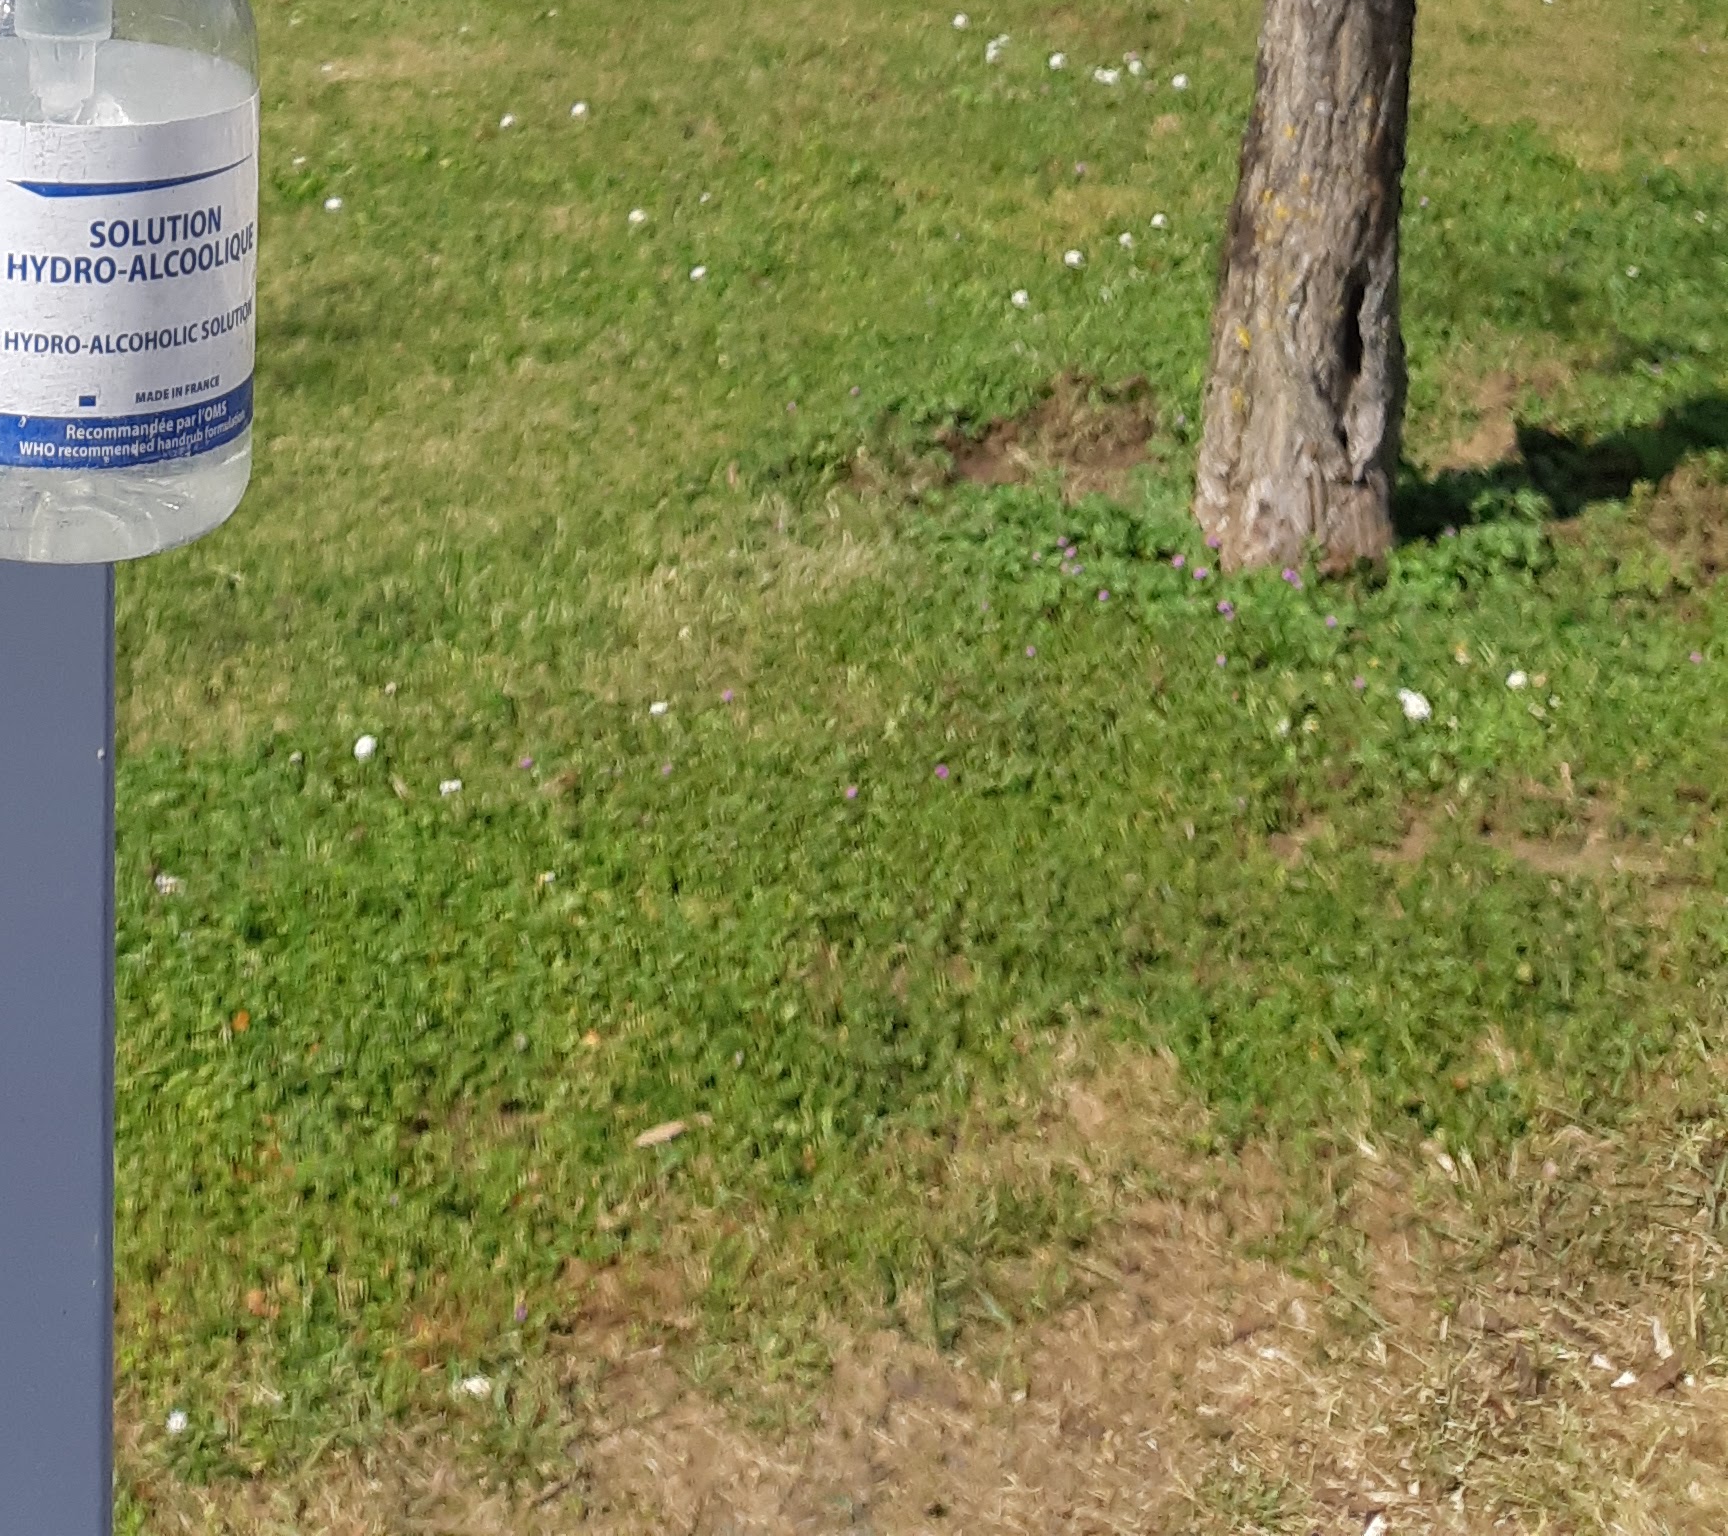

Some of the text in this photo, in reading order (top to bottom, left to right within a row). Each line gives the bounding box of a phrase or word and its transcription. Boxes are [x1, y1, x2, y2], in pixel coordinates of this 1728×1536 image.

[90, 206, 221, 248] SOLUTION
[7, 223, 254, 283] HYDRO-ALCOOLIQUE
[4, 297, 252, 354] HYDRO-ALCOHOLIC SOLUTION
[136, 375, 219, 403] MADE IN FRANCE
[20, 441, 54, 457] WHO
[58, 440, 154, 457] recommended
[157, 432, 203, 451] handrub
[66, 419, 173, 440] Recommandée
[176, 415, 196, 432] par
